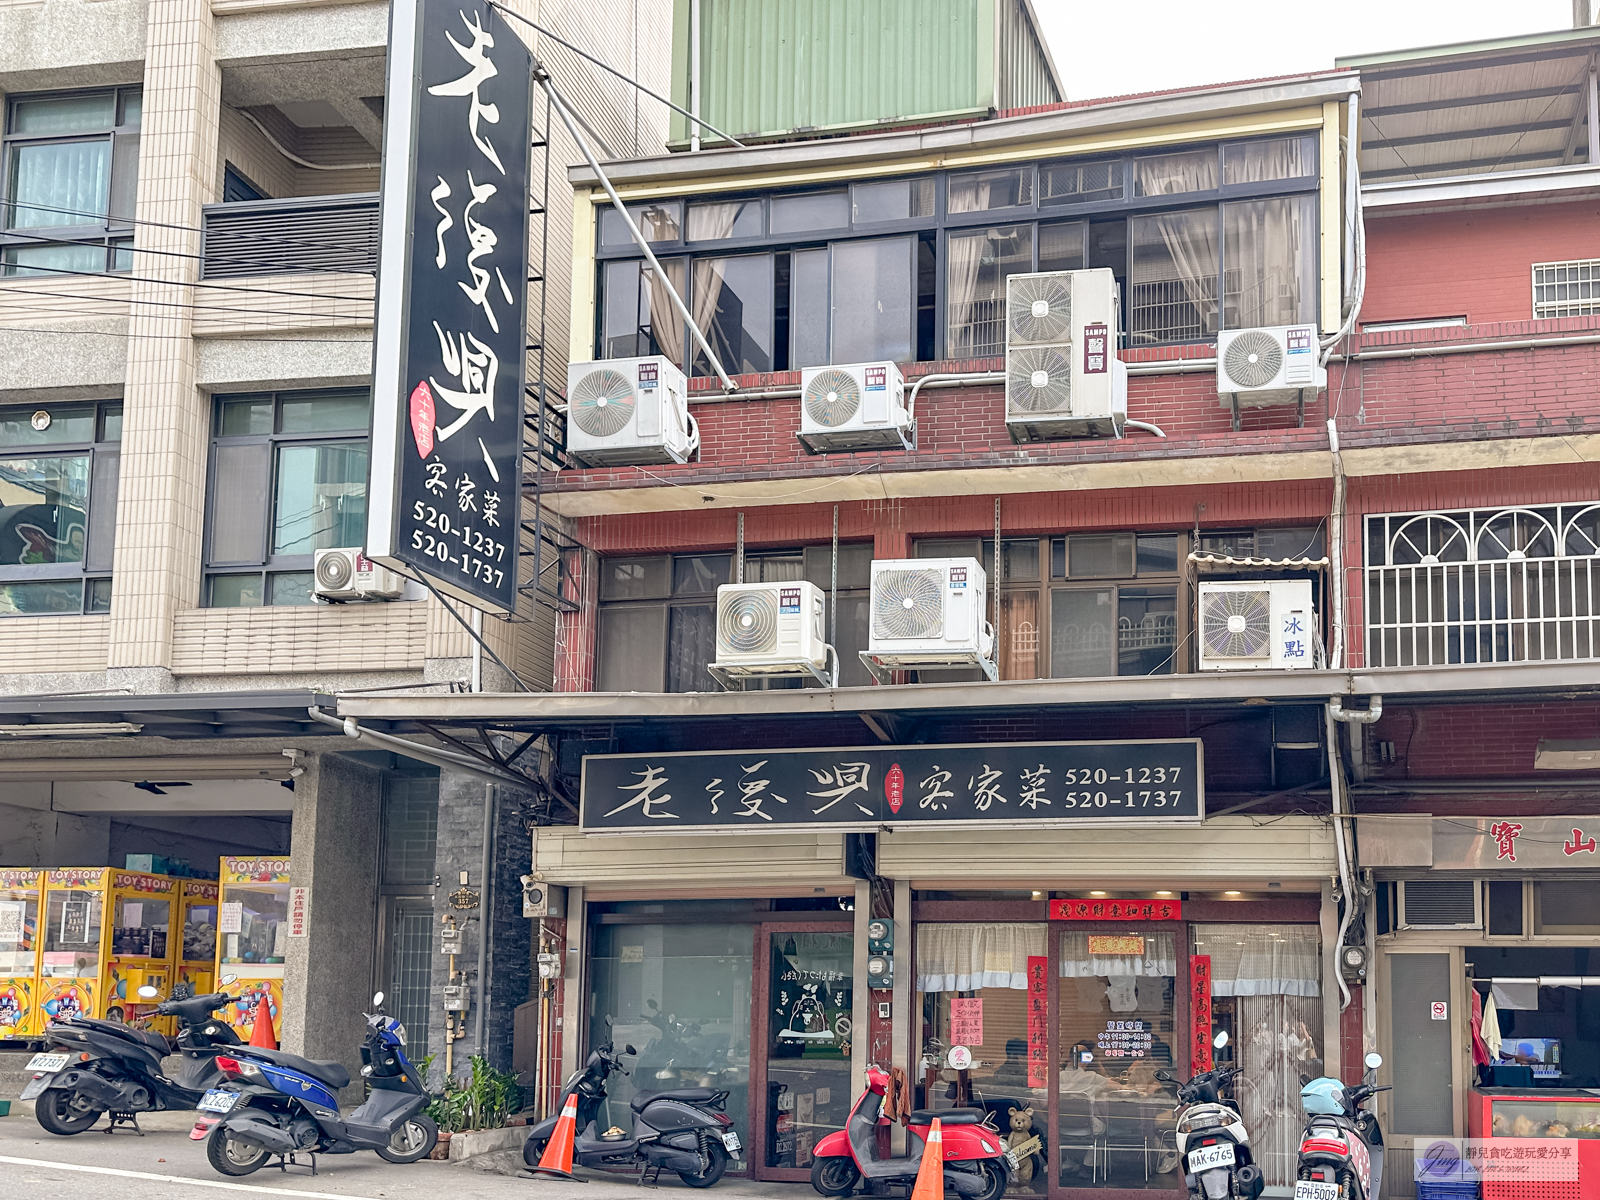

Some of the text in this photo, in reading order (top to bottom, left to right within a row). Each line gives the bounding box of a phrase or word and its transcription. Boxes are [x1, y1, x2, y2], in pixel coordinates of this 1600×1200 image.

[1287, 330, 1310, 338] SAMPO
[639, 364, 657, 372] SAMPO
[866, 368, 886, 376] SAMPO
[417, 386, 431, 449] 六十年老店
[425, 454, 500, 528] 客家菜
[412, 500, 505, 563] 520-1237
[411, 529, 504, 590] 520-1737
[780, 589, 800, 597] SAMPO
[1283, 617, 1305, 658] 冰點
[1065, 766, 1182, 785] 520-1237
[891, 767, 900, 806] 六十年老店
[918, 764, 1052, 812] 客家菜
[1065, 788, 1182, 809] 520-1737
[1491, 822, 1597, 862] 寶山
[10, 871, 40, 880] STORY
[51, 870, 103, 879] TOY STORY
[229, 861, 291, 873] TOY STOR
[116, 874, 174, 891] TOY STORY
[186, 883, 207, 895] TOY
[292, 888, 305, 936] 非本住戶請勿停車
[1015, 1143, 1038, 1158] elcome
[1190, 1149, 1233, 1168] MAK-6765
[1296, 1186, 1336, 1200] EPH-5009
